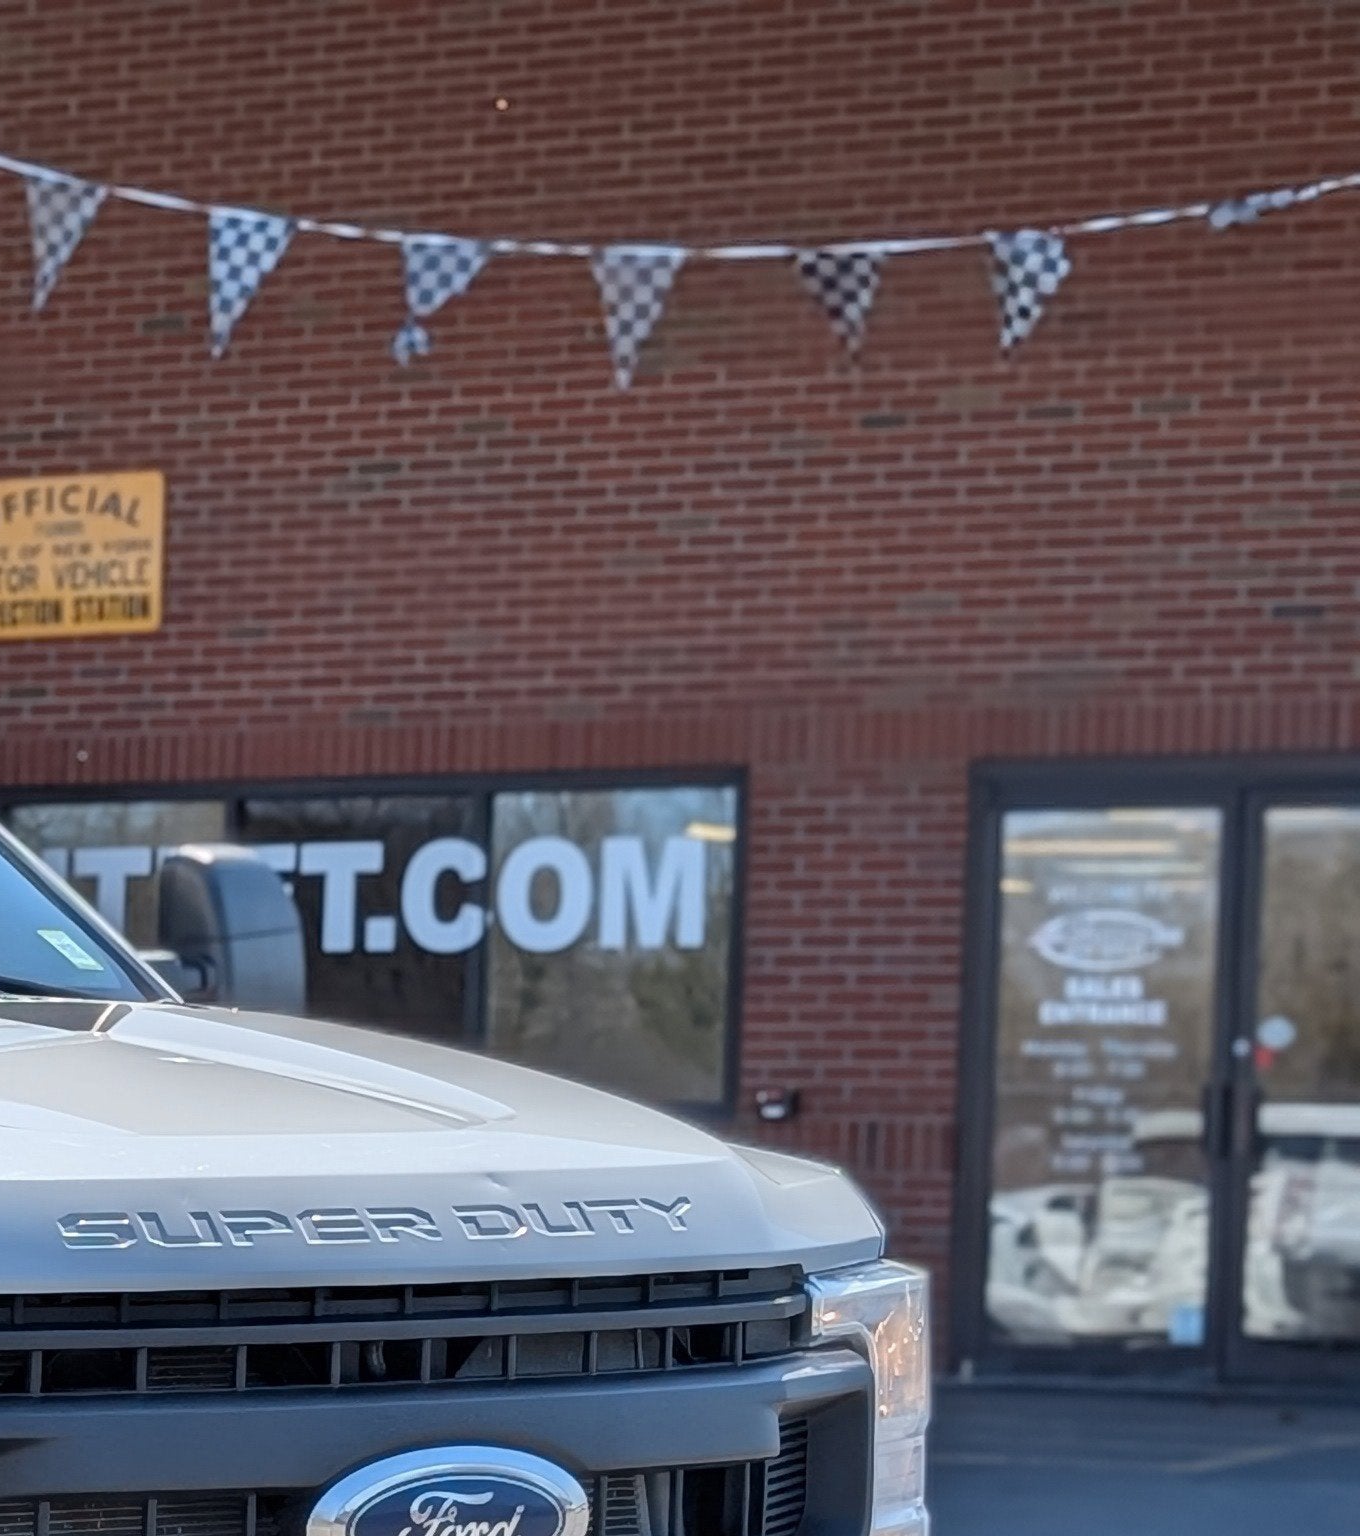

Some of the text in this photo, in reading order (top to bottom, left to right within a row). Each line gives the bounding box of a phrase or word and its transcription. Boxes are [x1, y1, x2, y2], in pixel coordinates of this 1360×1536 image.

[50, 556, 151, 591] VEHICLE
[55, 1195, 693, 1250] SUPER DUTY
